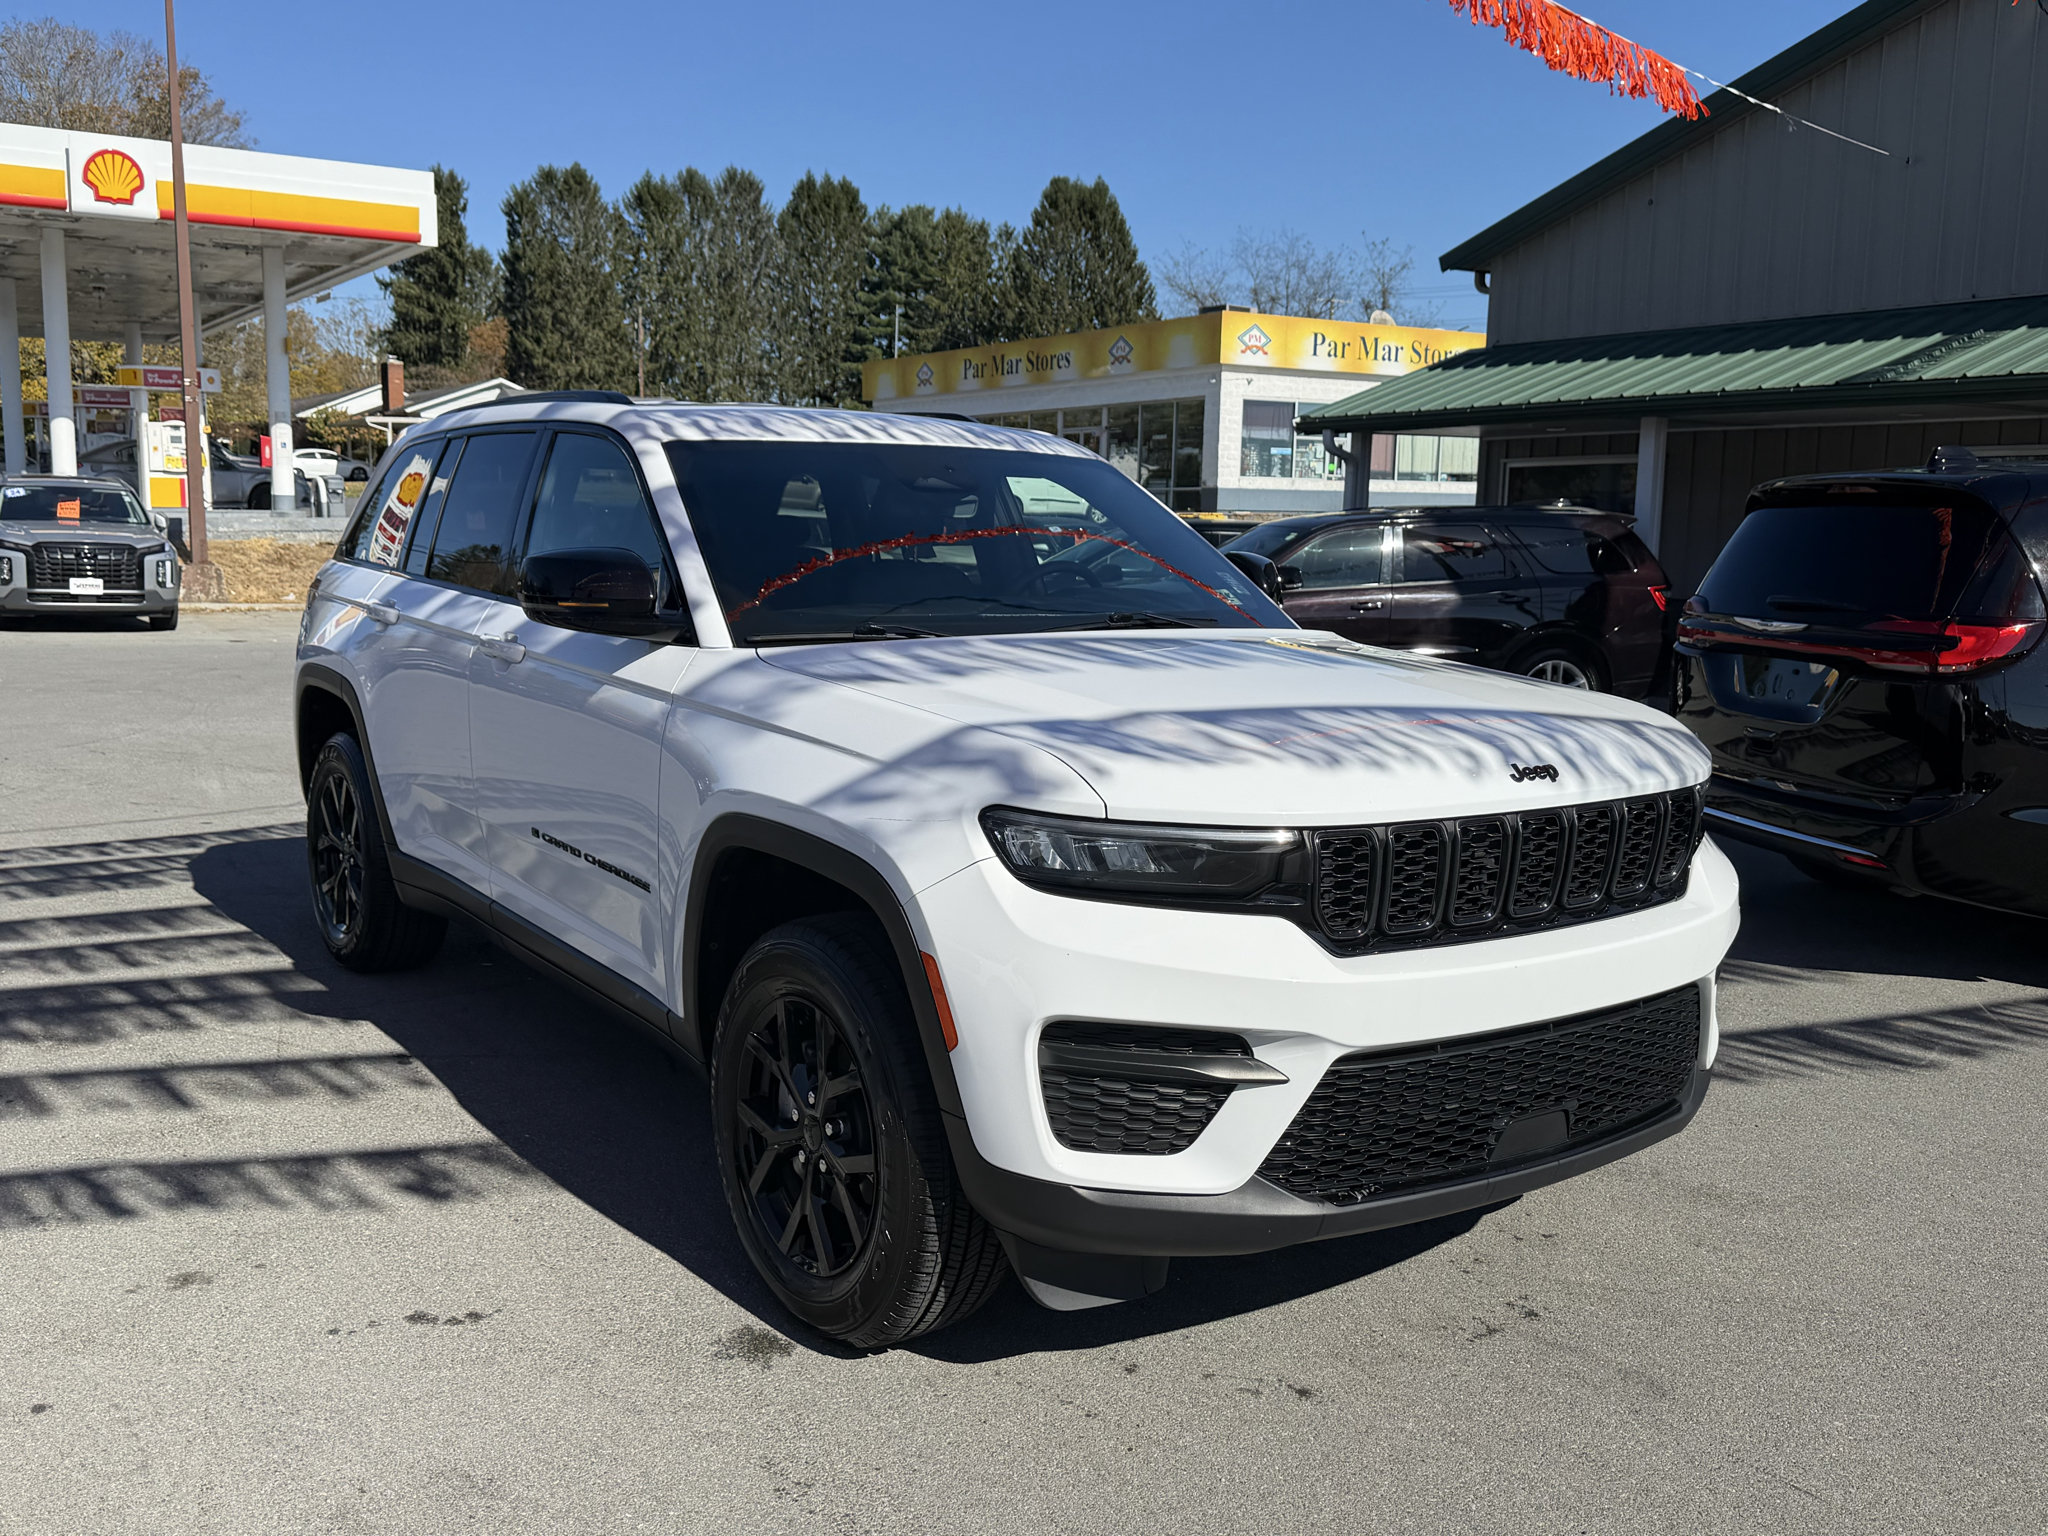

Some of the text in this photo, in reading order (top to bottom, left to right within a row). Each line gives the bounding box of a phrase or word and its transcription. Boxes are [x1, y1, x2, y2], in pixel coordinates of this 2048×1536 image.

[1248, 334, 1261, 343] PM
[1312, 332, 1459, 365] Par Mar Stor
[963, 350, 1071, 380] Par Mar Stores
[1509, 763, 1559, 783] Jeep
[541, 832, 651, 894] GRAND CHEROKEE
